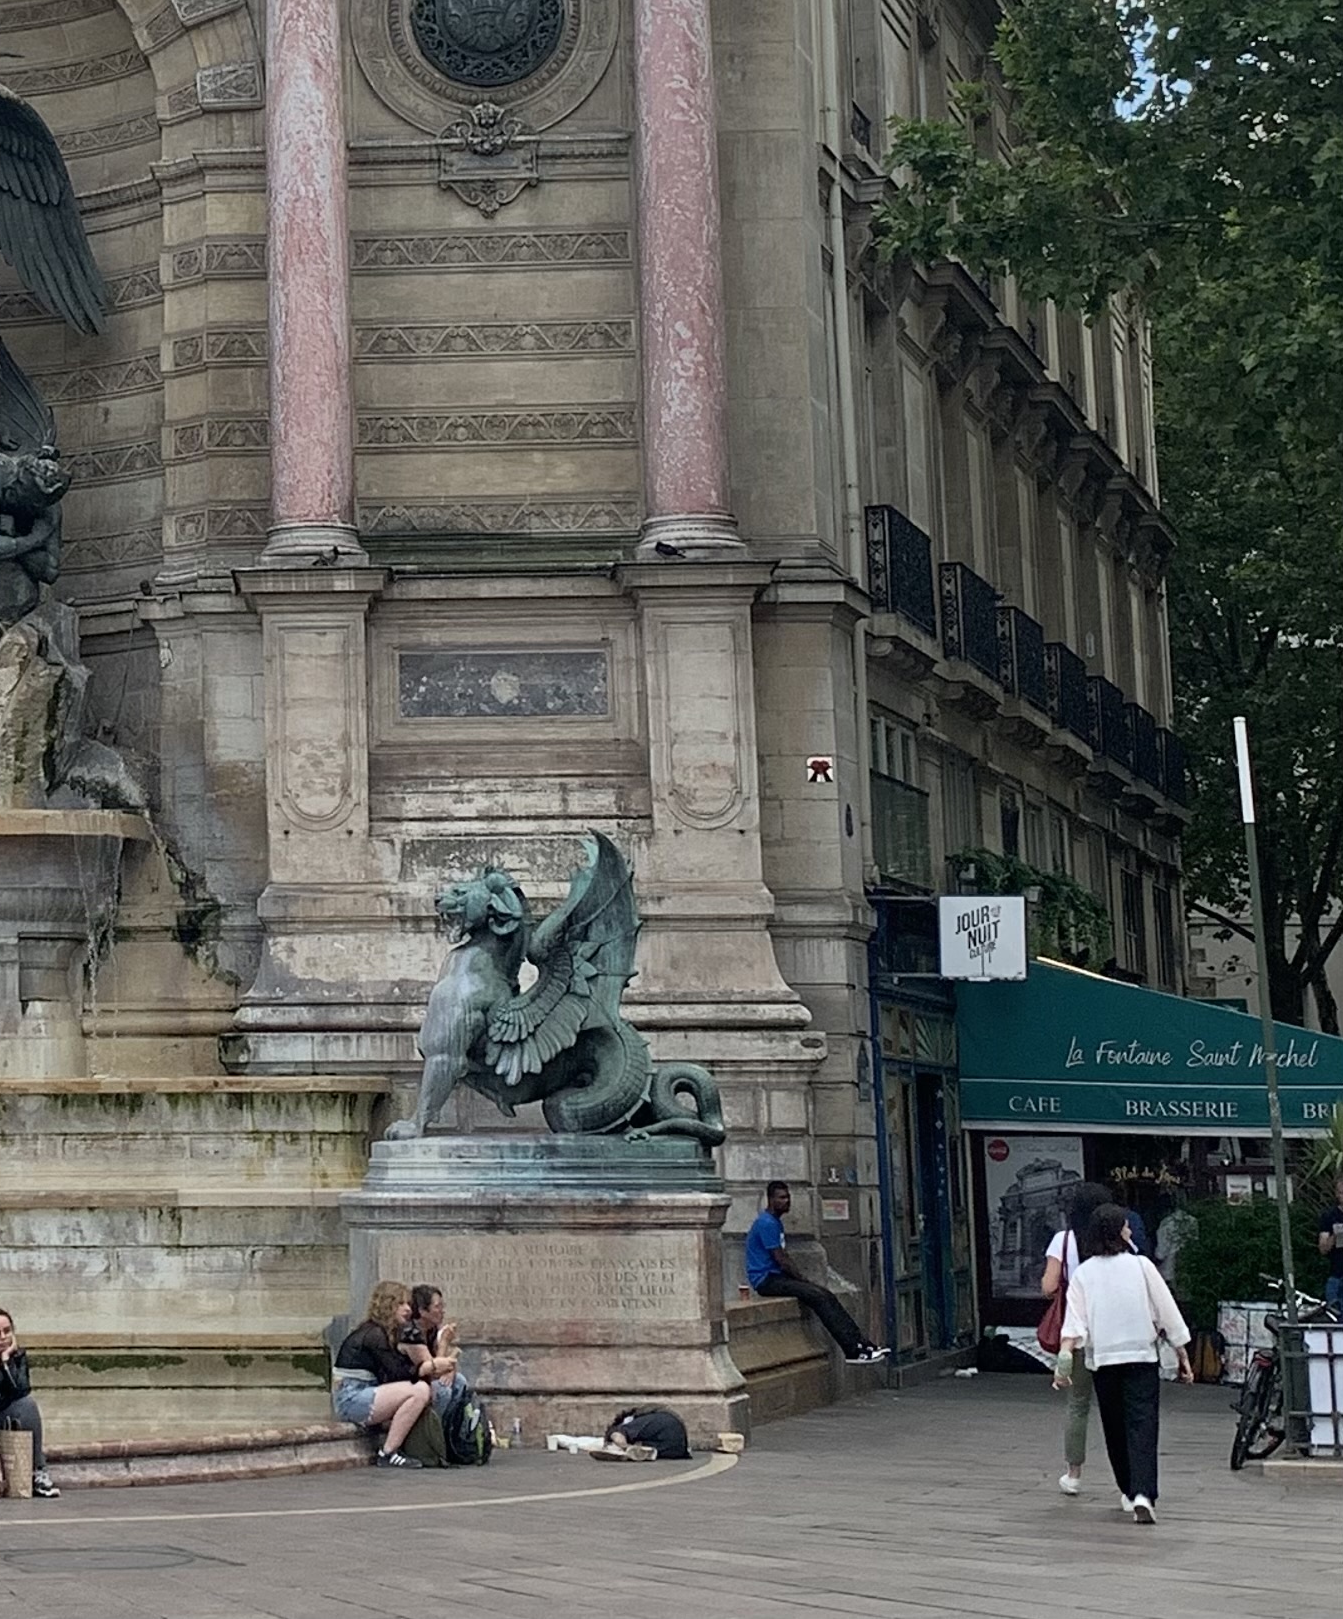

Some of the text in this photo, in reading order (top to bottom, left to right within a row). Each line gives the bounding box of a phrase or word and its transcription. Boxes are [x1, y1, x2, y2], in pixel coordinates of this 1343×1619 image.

[955, 905, 990, 935] JOUR
[967, 918, 1001, 950] NUIT
[1065, 1036, 1085, 1068] La
[1096, 1039, 1174, 1066] Fontaine
[1186, 1039, 1244, 1067] Saint
[1008, 1095, 1062, 1113] CAFE
[1125, 1099, 1239, 1119] BRASSERIE
